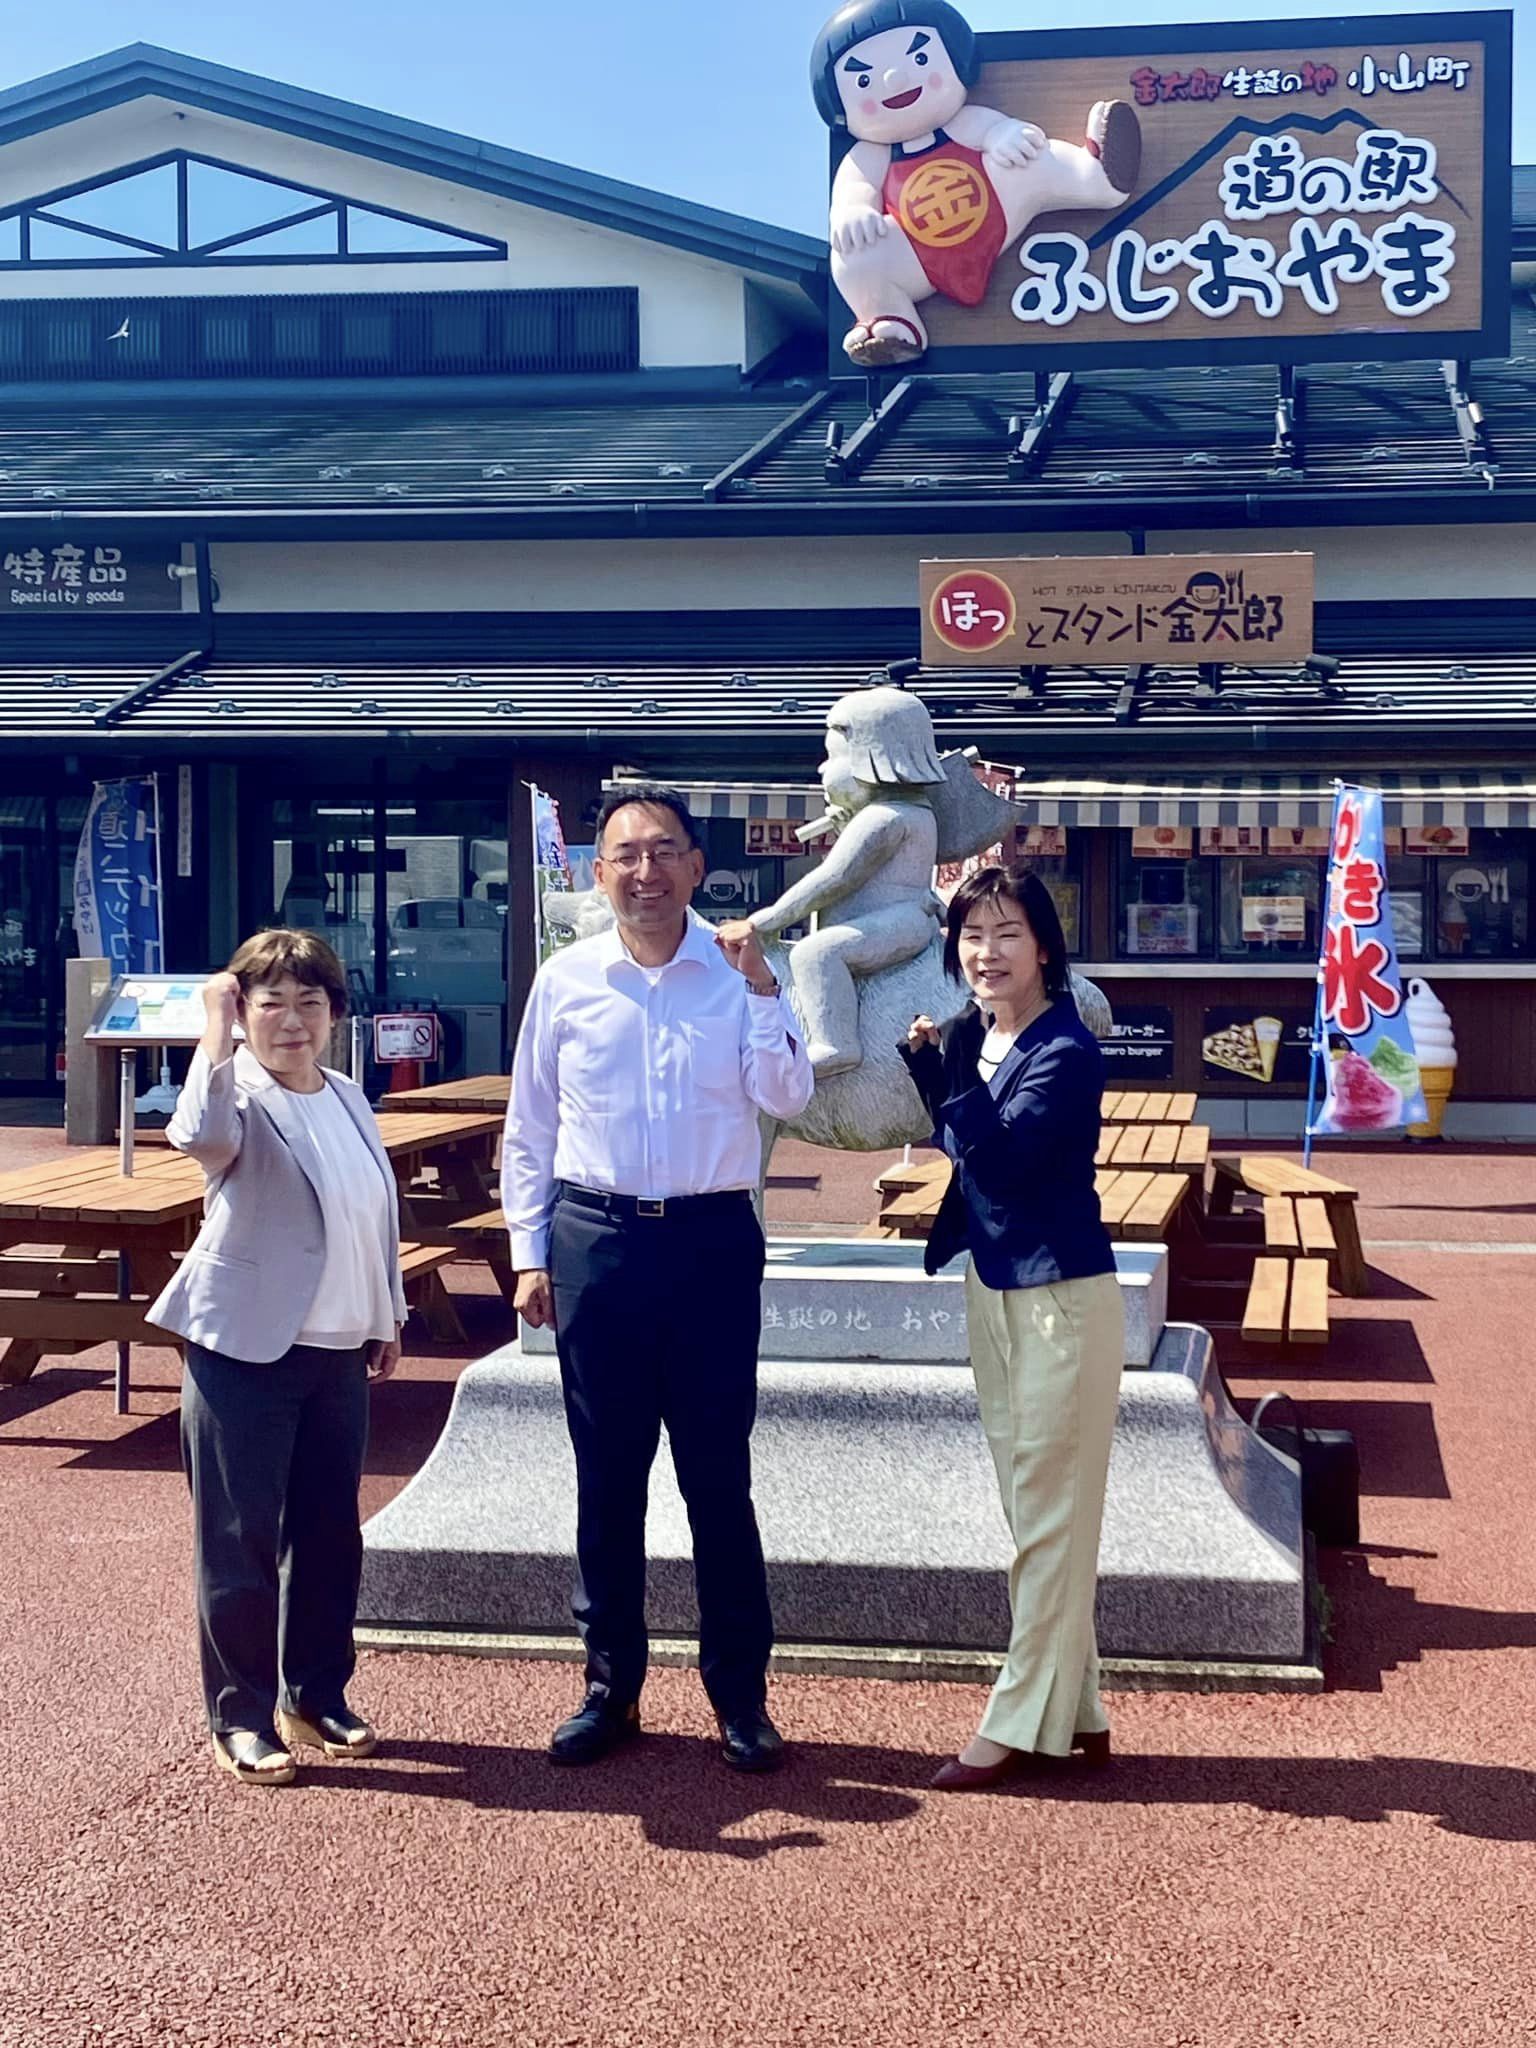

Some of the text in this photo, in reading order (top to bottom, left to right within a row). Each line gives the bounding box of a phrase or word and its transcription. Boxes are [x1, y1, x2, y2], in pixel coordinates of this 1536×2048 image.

[1131, 52, 1471, 104] 金太郎生誕の地 小山町
[1224, 131, 1433, 217] 道の駅
[905, 166, 981, 237] 金
[1011, 215, 1455, 325] ふじおやま
[3, 543, 127, 587] 特産品
[11, 589, 124, 604] Specialty goods
[1032, 585, 1057, 596] HOT
[1066, 584, 1105, 595] STAND
[764, 1303, 872, 1331] 生誕の地
